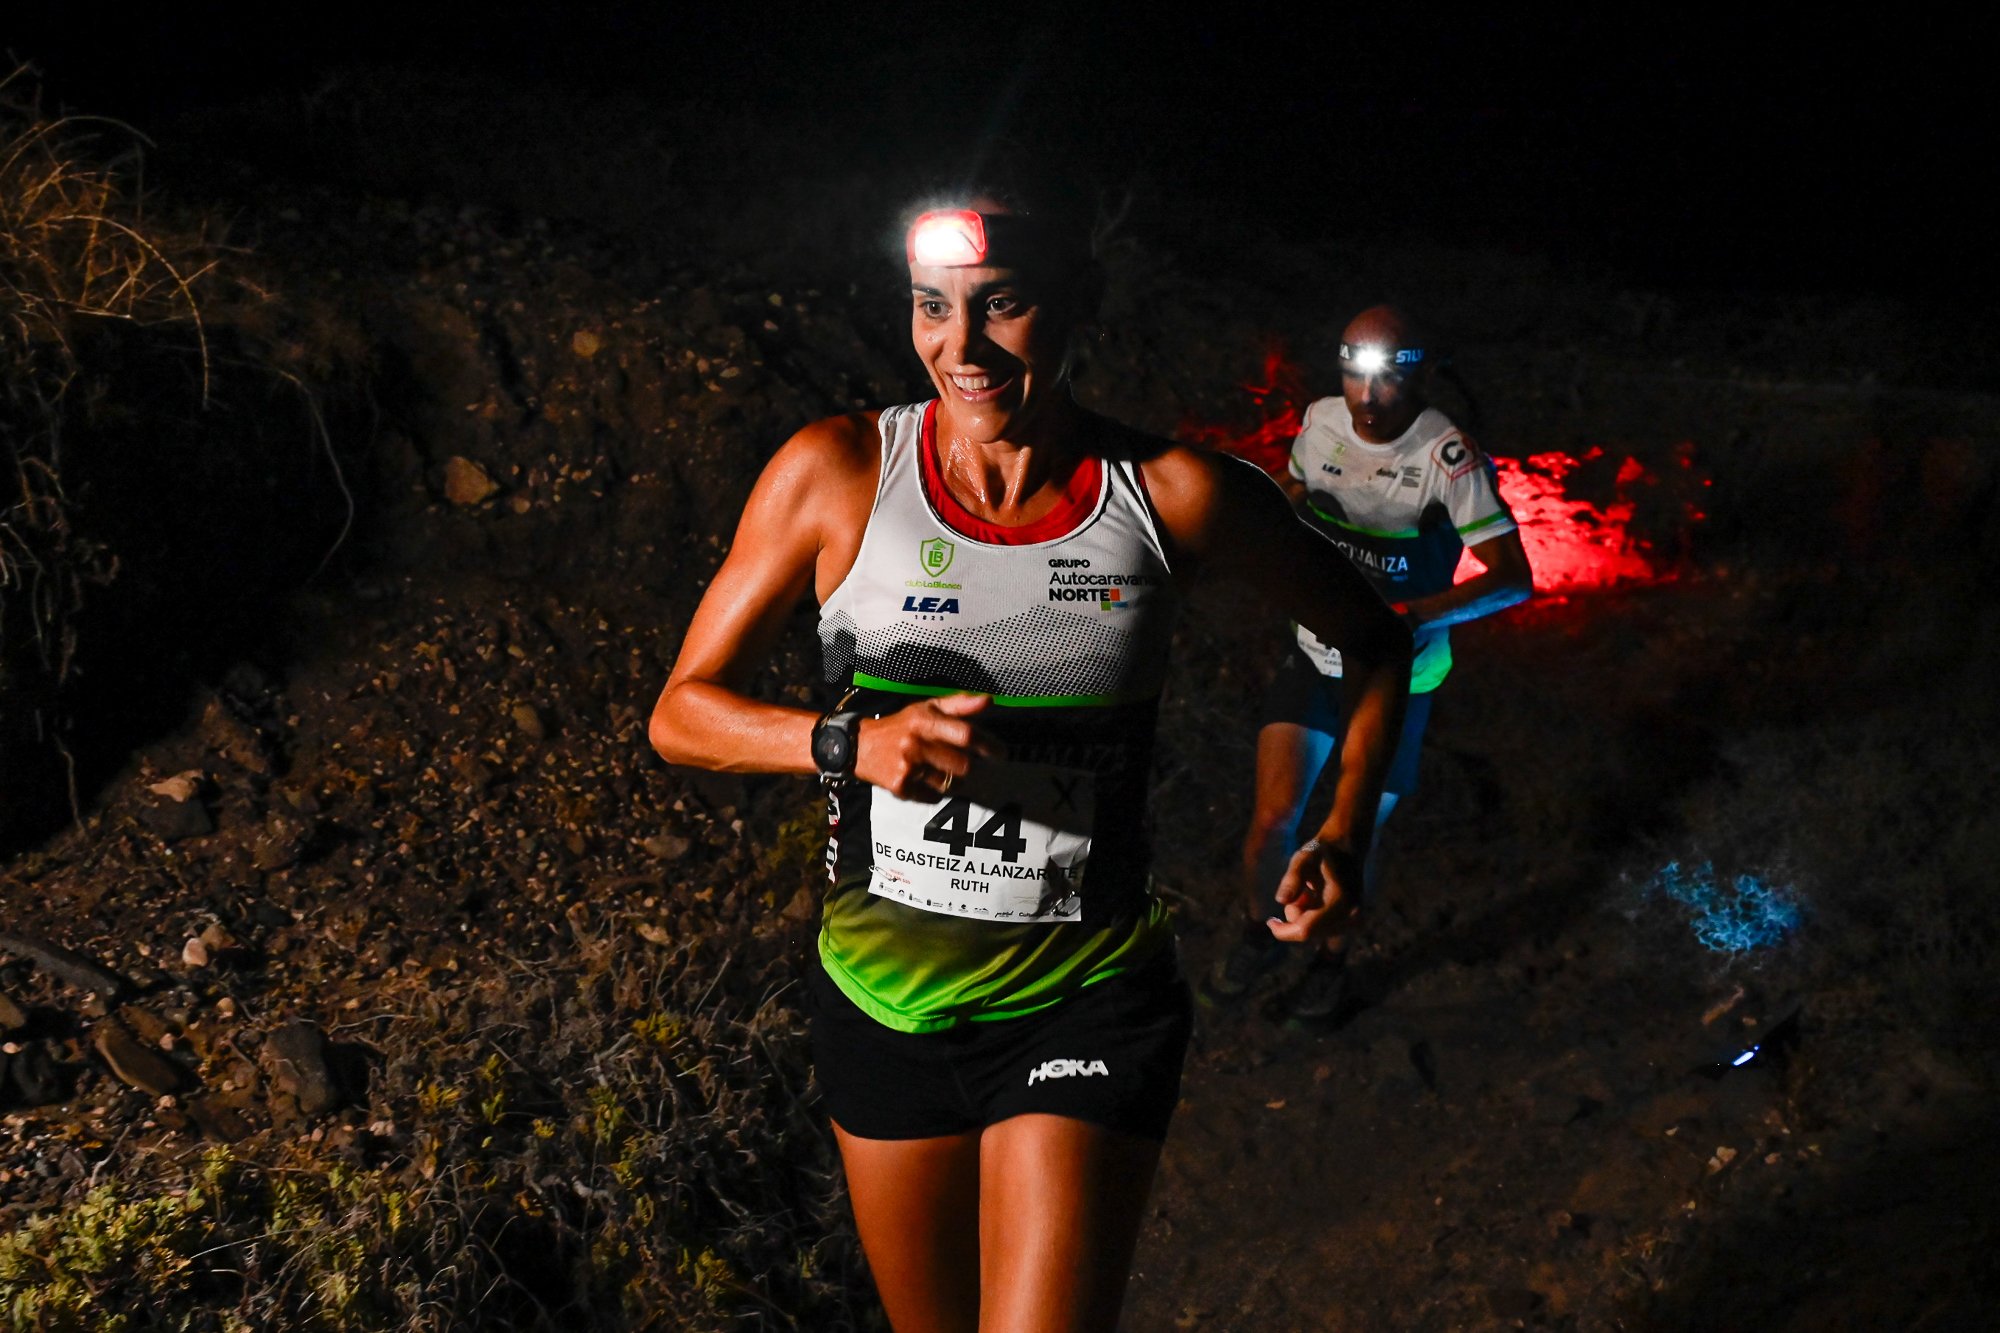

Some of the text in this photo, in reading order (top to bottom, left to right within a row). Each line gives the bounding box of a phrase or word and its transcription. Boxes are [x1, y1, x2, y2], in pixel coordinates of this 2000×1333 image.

[1048, 559, 1091, 568] GRUPO
[1048, 588, 1111, 602] NORTE
[902, 596, 960, 614] LEA
[923, 797, 1027, 863] 44
[876, 842, 1079, 881] DE GASTEIZ A LANZARTE
[950, 877, 990, 894] RUTH
[1027, 1059, 1109, 1087] HOKA
